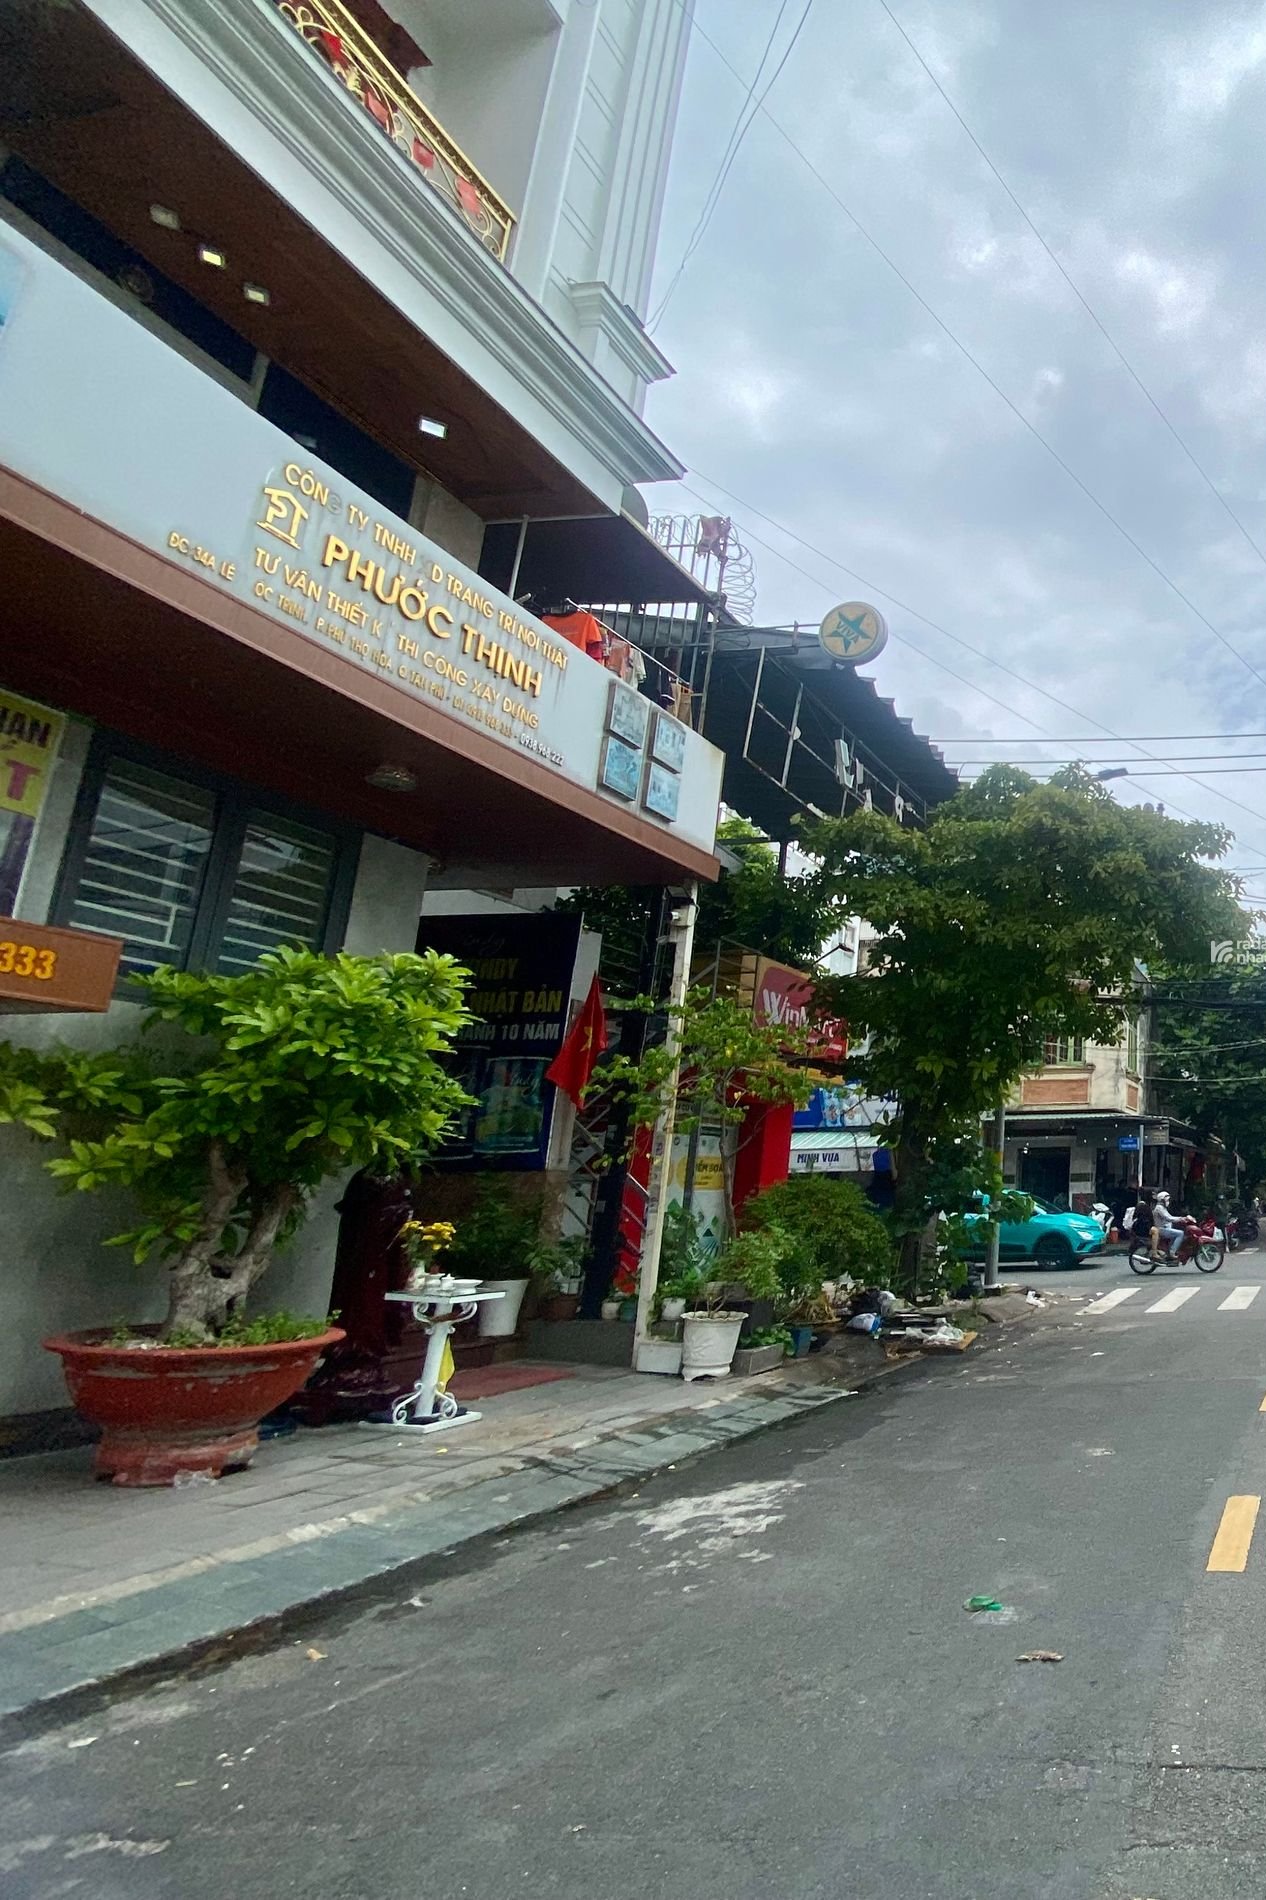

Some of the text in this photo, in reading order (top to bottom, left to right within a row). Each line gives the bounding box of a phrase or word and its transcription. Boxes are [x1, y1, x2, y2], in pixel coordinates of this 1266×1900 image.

[348, 504, 369, 532] TY
[374, 523, 417, 566] TNHH
[446, 573, 495, 619] TRANG
[254, 547, 281, 575] TƯ
[396, 633, 420, 659] THI
[422, 651, 469, 688] CÔNG
[322, 533, 544, 699] PHƯỚC THỊNH
[0, 942, 56, 979] 333
[522, 983, 564, 1014] BẢN
[501, 1024, 519, 1041] 10
[523, 1020, 560, 1041] NĂM
